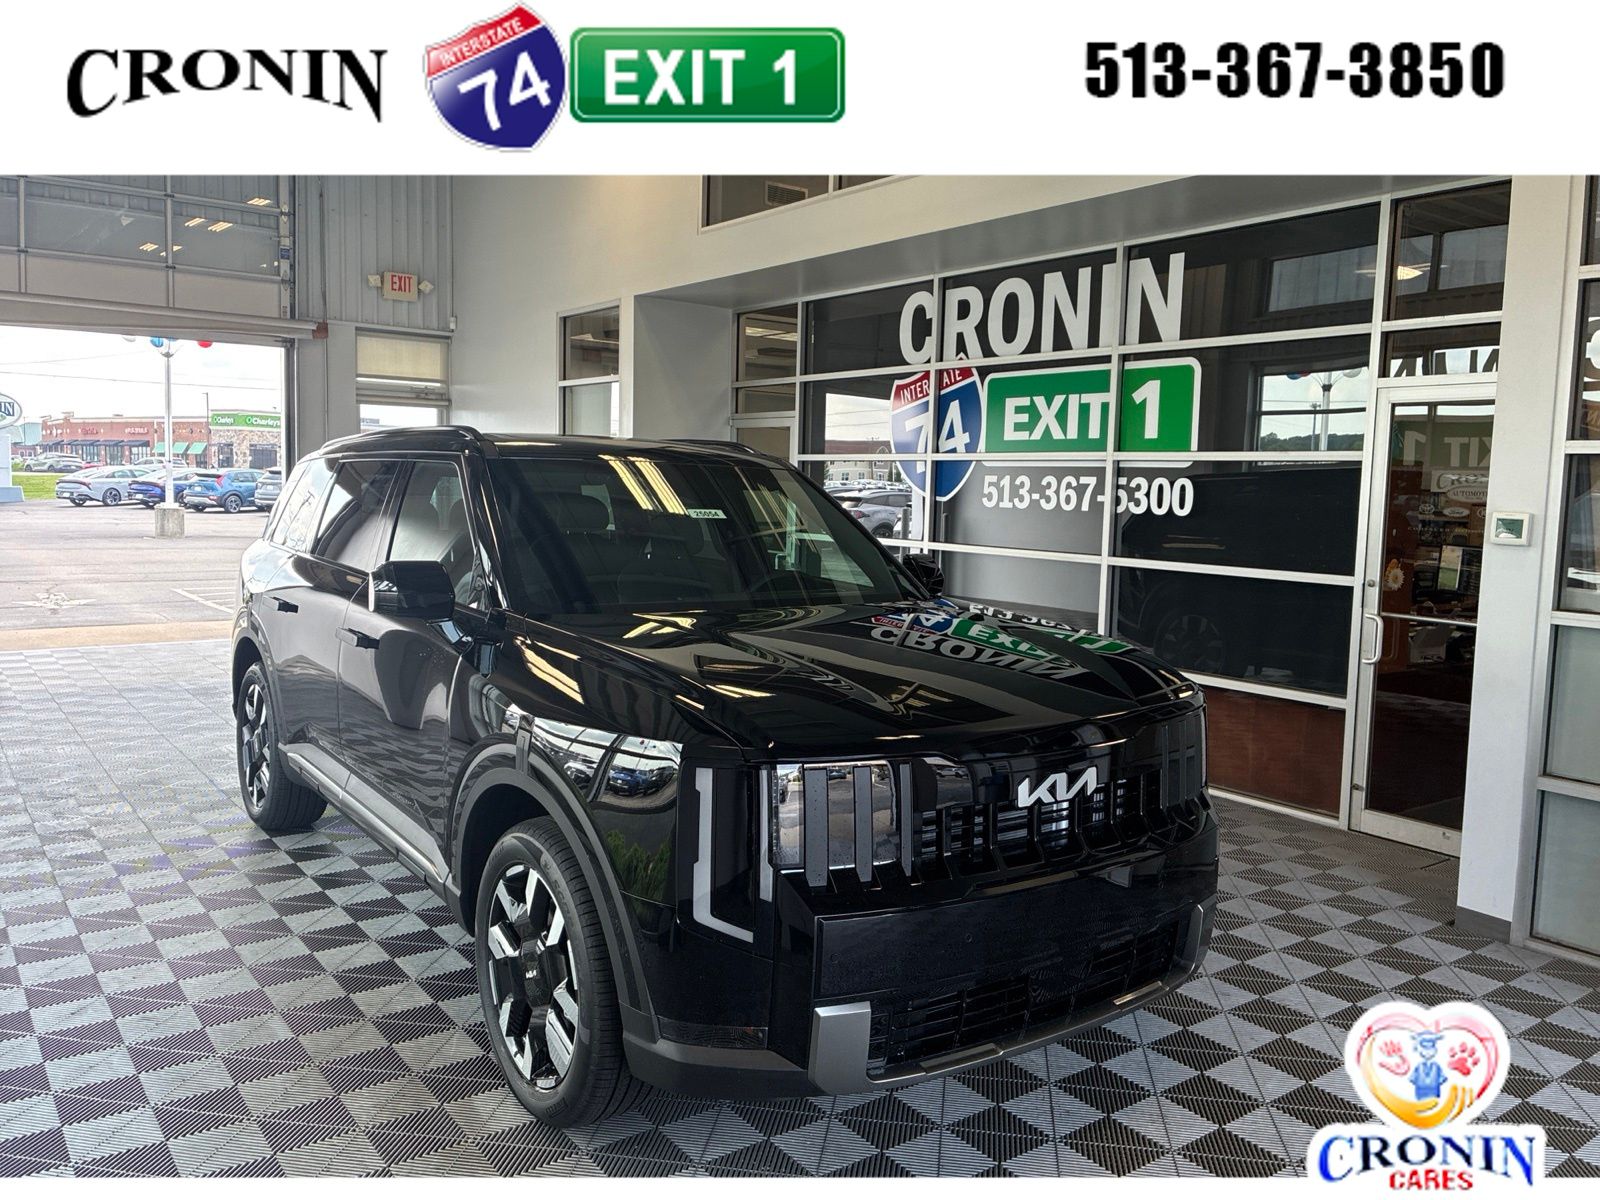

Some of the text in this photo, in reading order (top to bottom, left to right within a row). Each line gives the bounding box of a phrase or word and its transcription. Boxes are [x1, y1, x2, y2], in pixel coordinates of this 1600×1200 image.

[390, 274, 413, 293] EXIT
[899, 251, 1186, 365] CRONIN
[900, 369, 963, 404] INTERATE
[1003, 379, 1161, 441] EXIT 1
[905, 400, 970, 474] 74
[982, 475, 1195, 517] 513-367-5300
[1017, 766, 1098, 808] KIA
